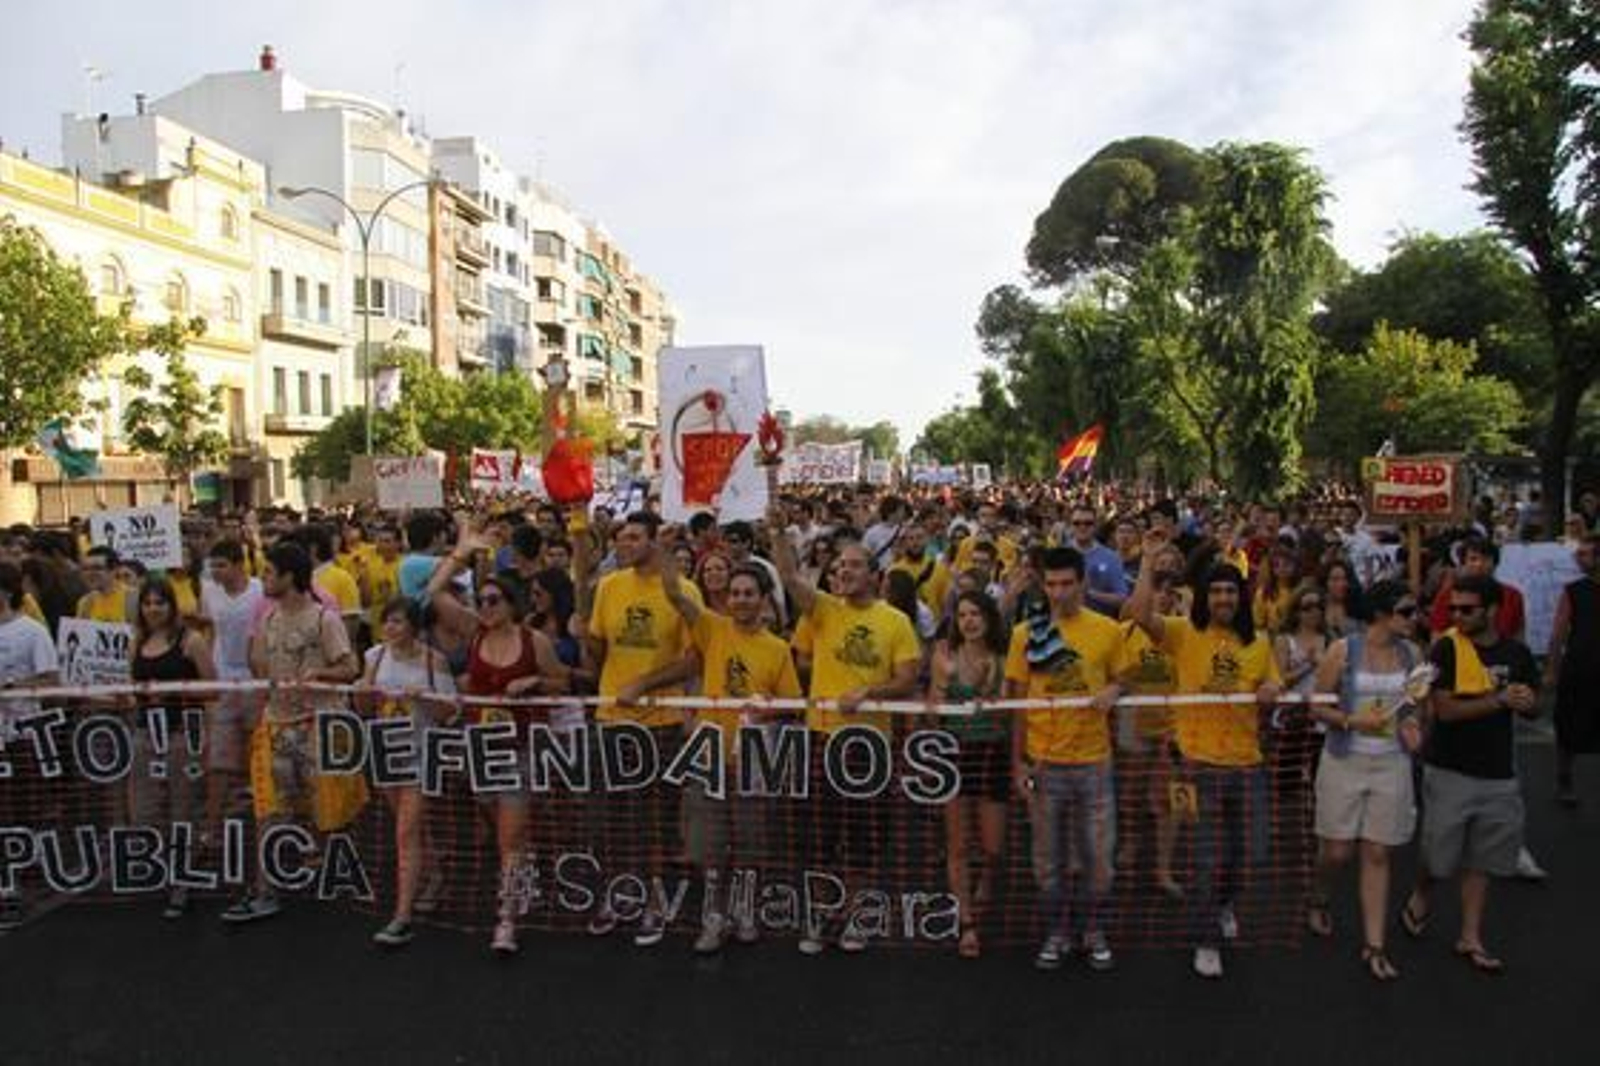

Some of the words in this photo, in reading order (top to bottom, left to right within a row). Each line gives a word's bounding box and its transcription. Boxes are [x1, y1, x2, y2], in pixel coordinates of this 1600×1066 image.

[128, 513, 157, 532] NO
[96, 628, 129, 652] NO
[316, 709, 962, 802] DEFENDAMOS
[0, 818, 374, 899] PUBLICA
